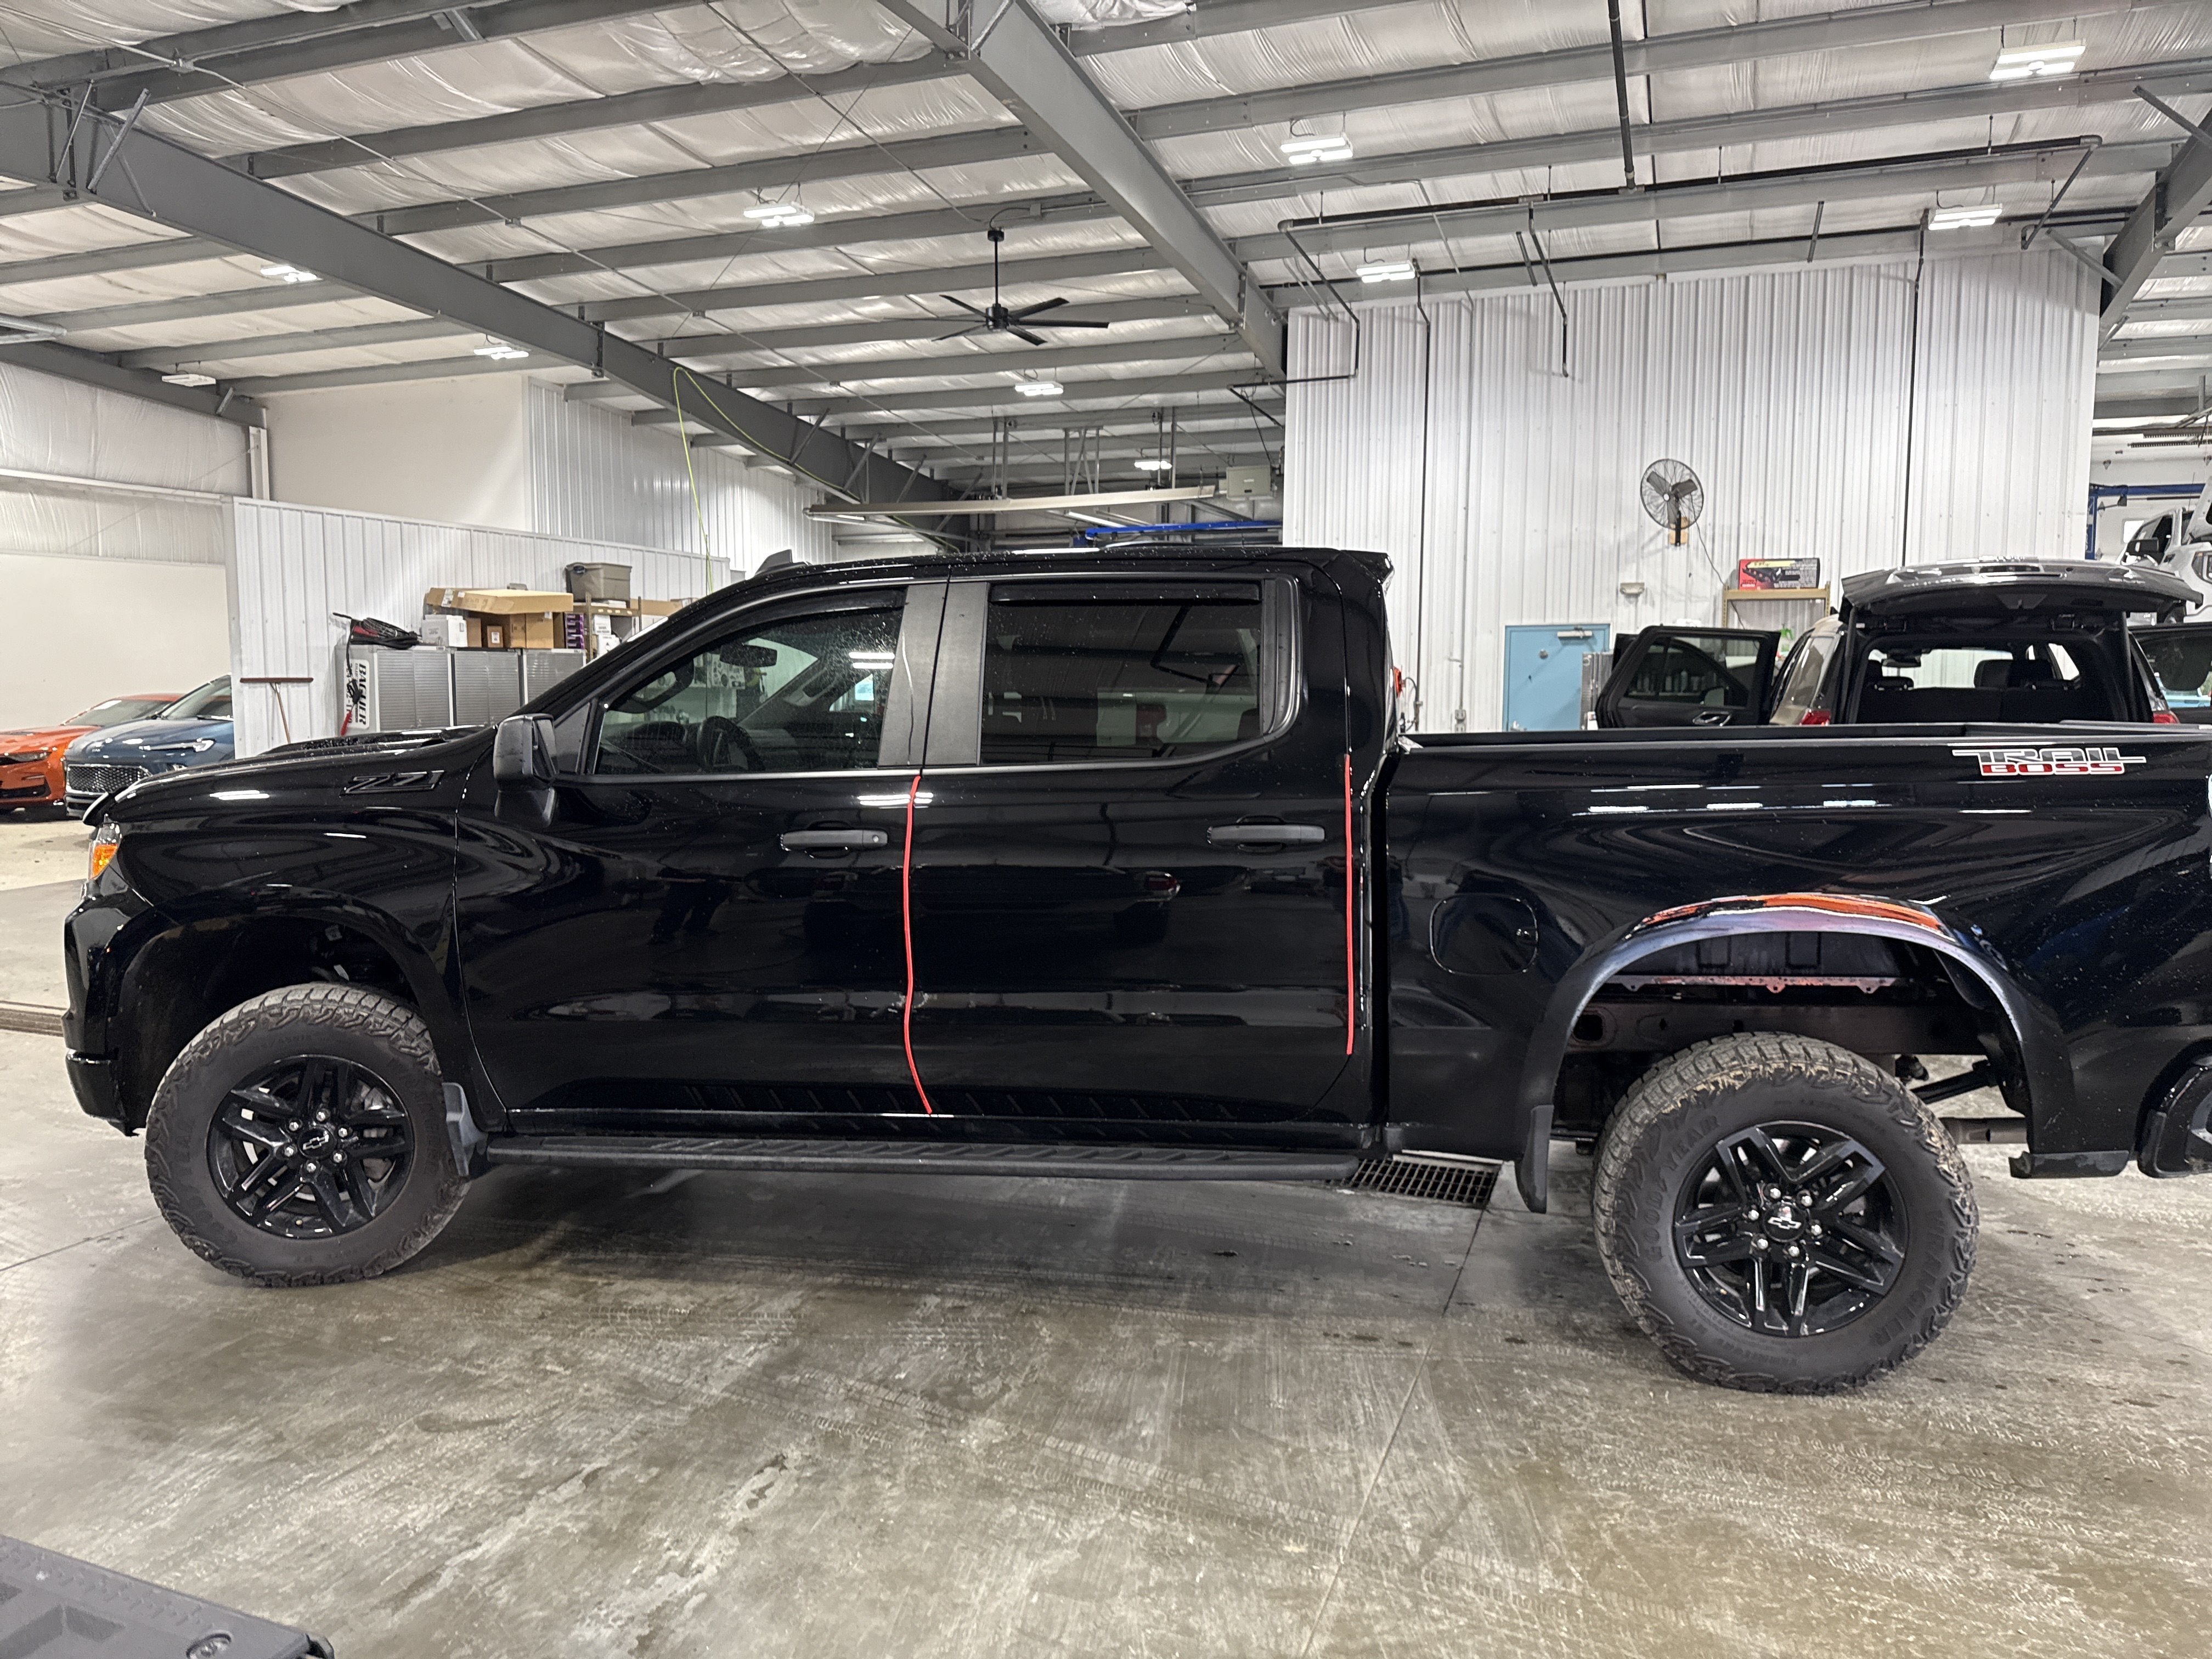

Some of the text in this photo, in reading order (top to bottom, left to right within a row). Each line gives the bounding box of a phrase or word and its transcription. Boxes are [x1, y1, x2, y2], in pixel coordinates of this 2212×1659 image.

[1952, 747, 2146, 763] TRAIL
[1981, 761, 2125, 776] BOSS
[339, 770, 445, 794] Z71
